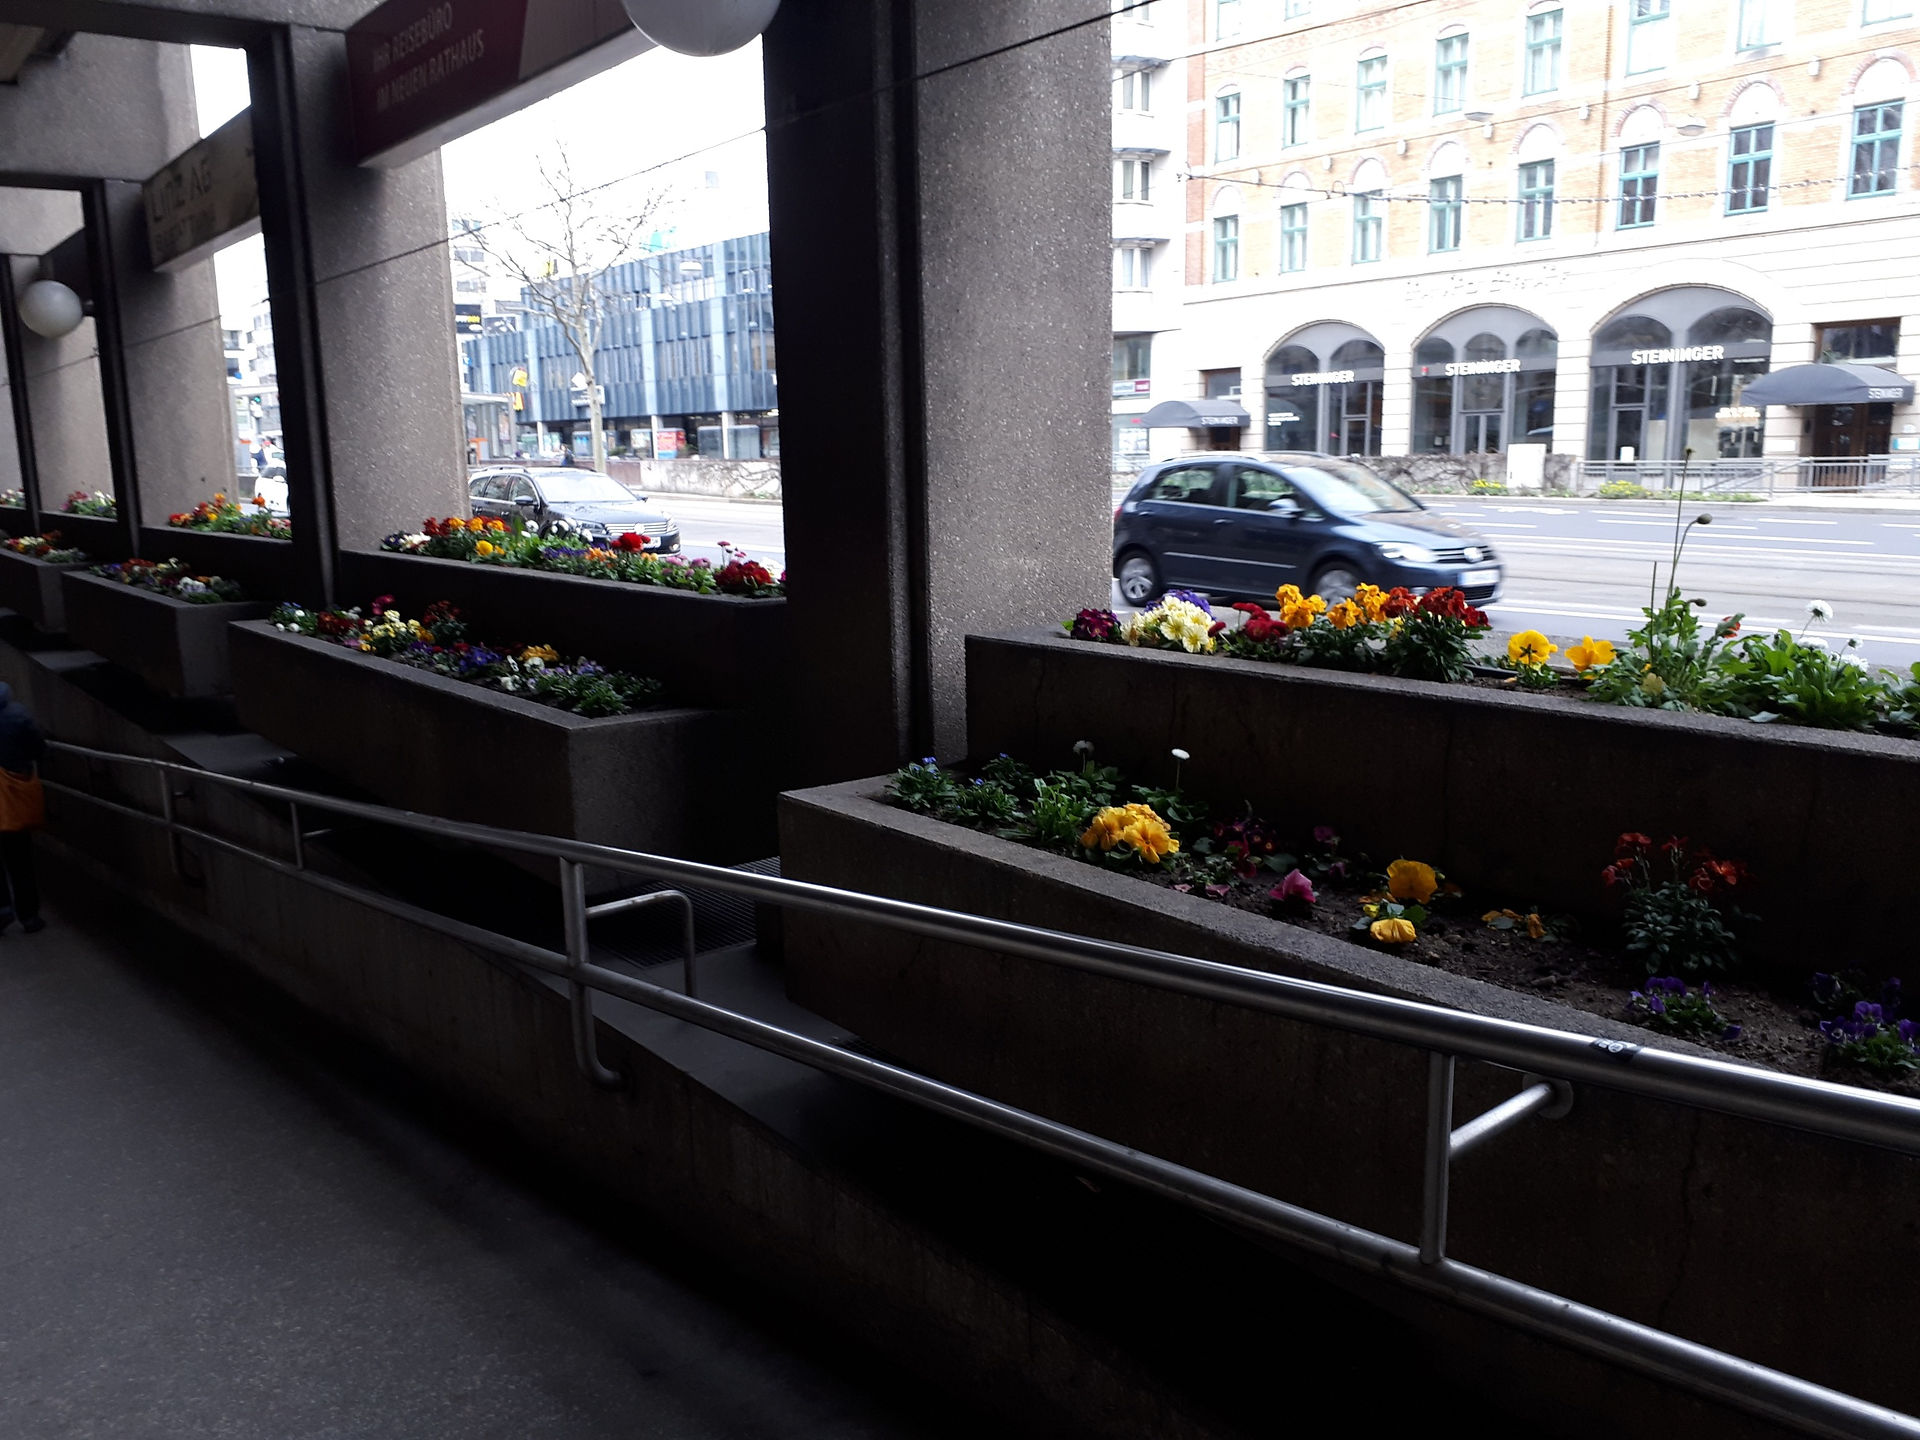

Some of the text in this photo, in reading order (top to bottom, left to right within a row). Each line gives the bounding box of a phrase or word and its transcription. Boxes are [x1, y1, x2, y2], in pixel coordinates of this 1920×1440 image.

[392, 2, 453, 62] REISEBÜRO
[391, 62, 428, 104] NEUEN
[429, 28, 484, 84] RATHAUS
[1631, 345, 1724, 365] STEININGER
[1445, 358, 1521, 377] STEININGER
[1290, 370, 1355, 387] STEININGER
[1201, 415, 1238, 426] STEININGER
